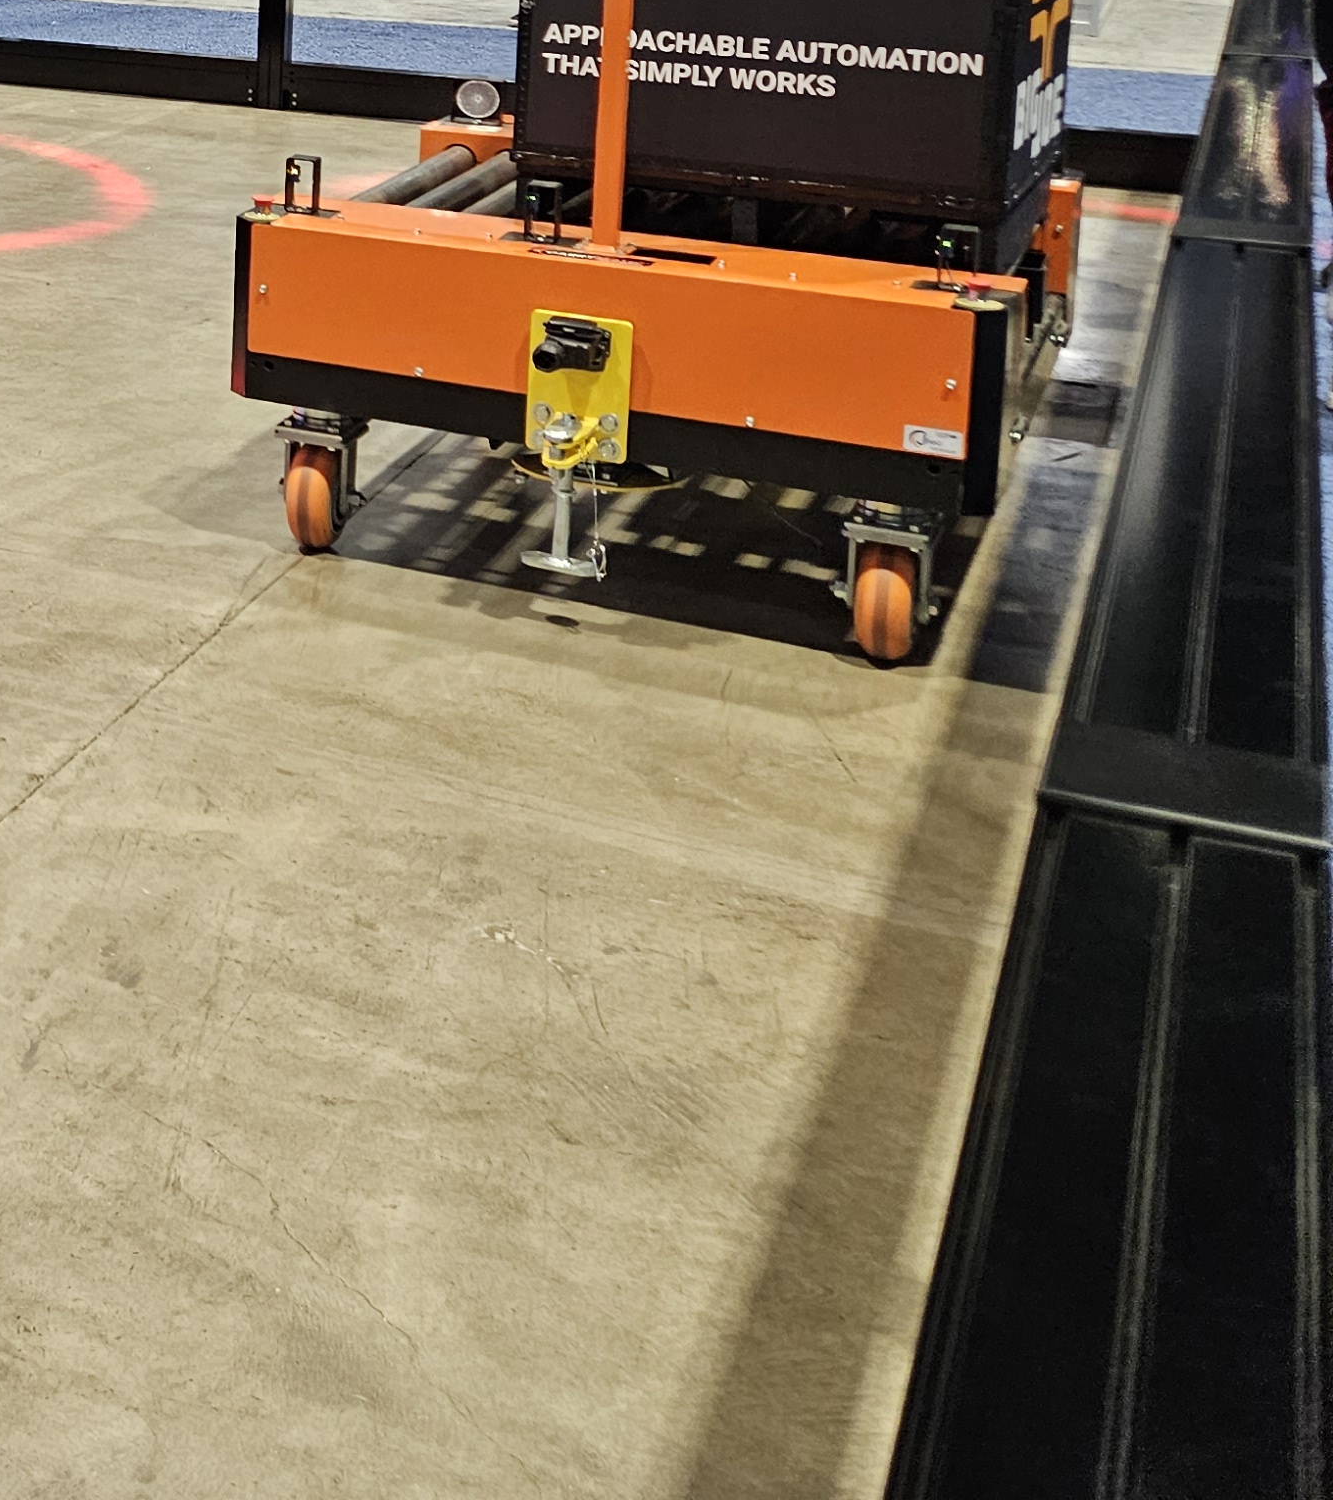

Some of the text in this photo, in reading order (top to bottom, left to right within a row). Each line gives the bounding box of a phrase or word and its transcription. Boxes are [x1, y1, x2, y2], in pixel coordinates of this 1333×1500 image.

[626, 58, 724, 88] SIMPLY
[730, 67, 836, 98] WORKS
[775, 41, 984, 78] AUTOMATION
